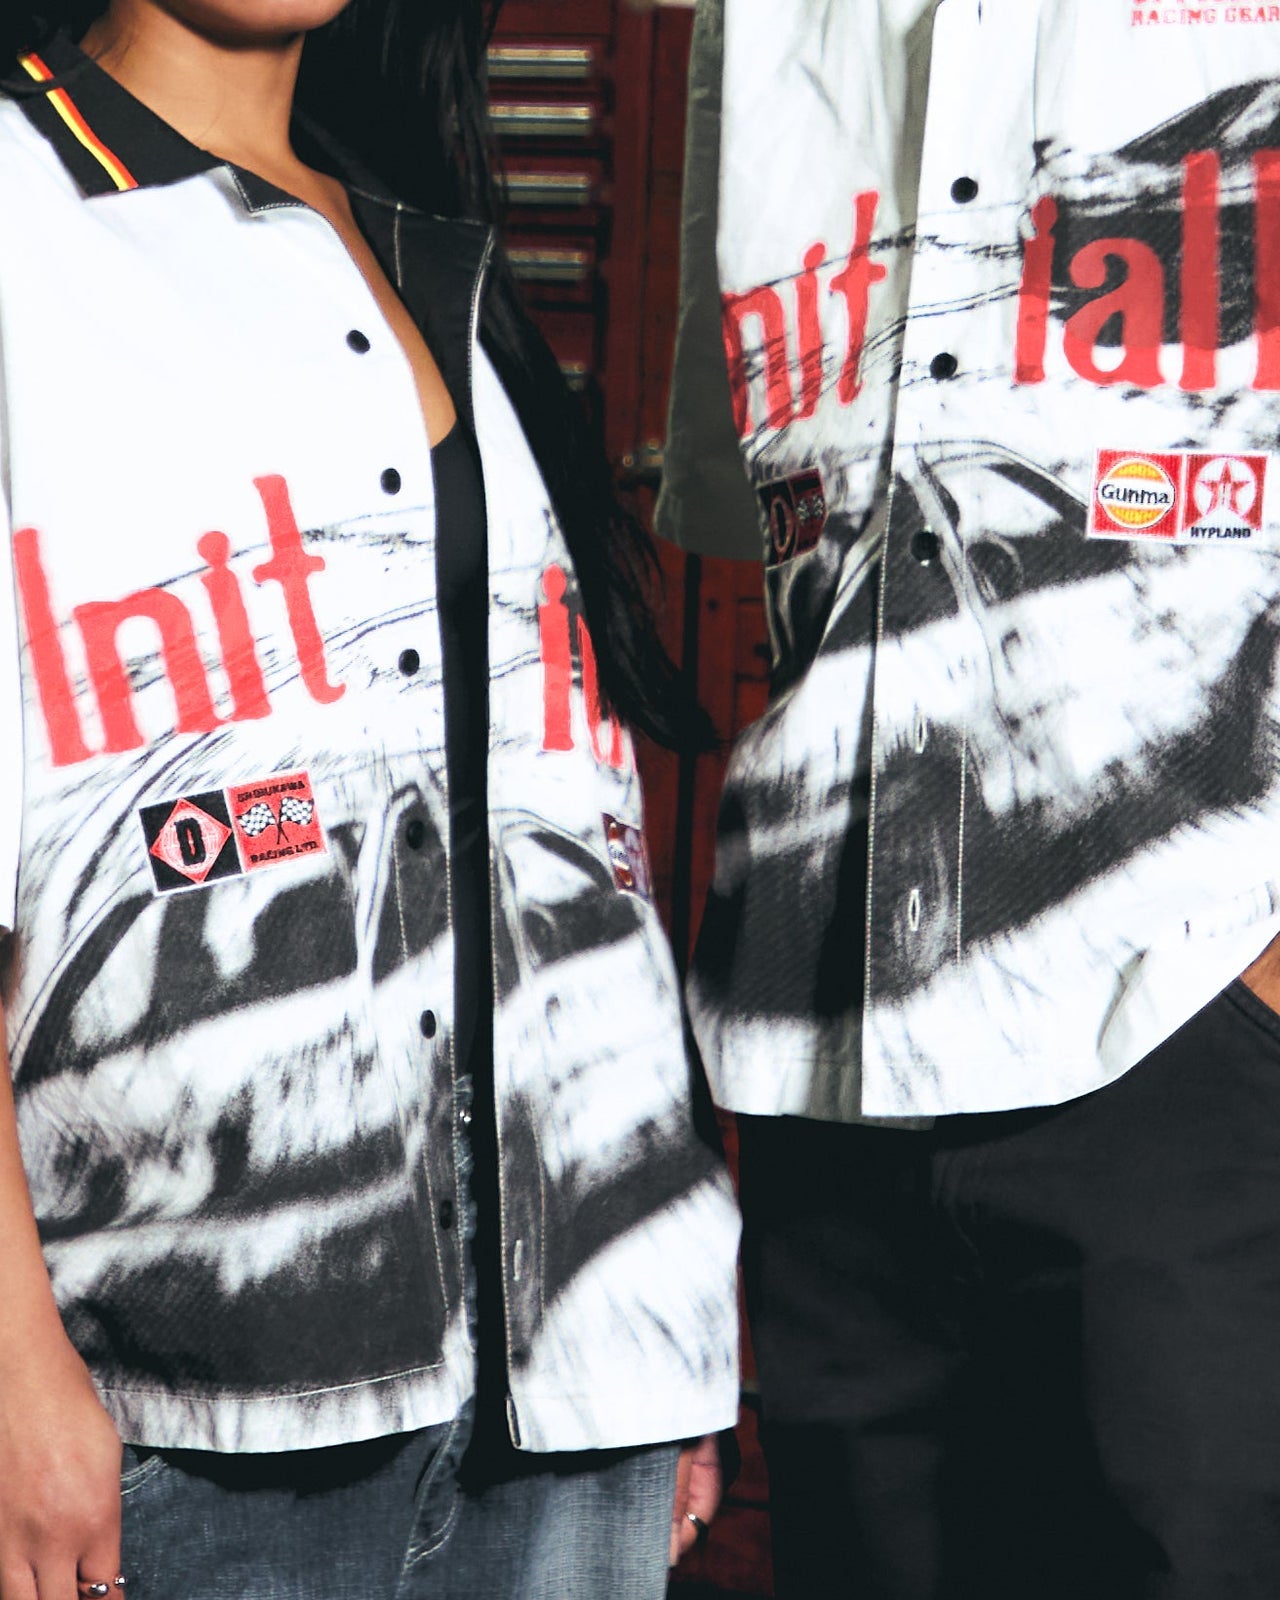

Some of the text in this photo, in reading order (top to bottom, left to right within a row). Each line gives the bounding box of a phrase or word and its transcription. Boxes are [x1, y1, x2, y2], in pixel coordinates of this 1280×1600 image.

[1131, 5, 1280, 27] RACING GEAR
[1101, 483, 1171, 504] Gunma
[1190, 525, 1252, 539] HYPLAND
[13, 473, 346, 768] Init
[250, 847, 294, 864] RACING
